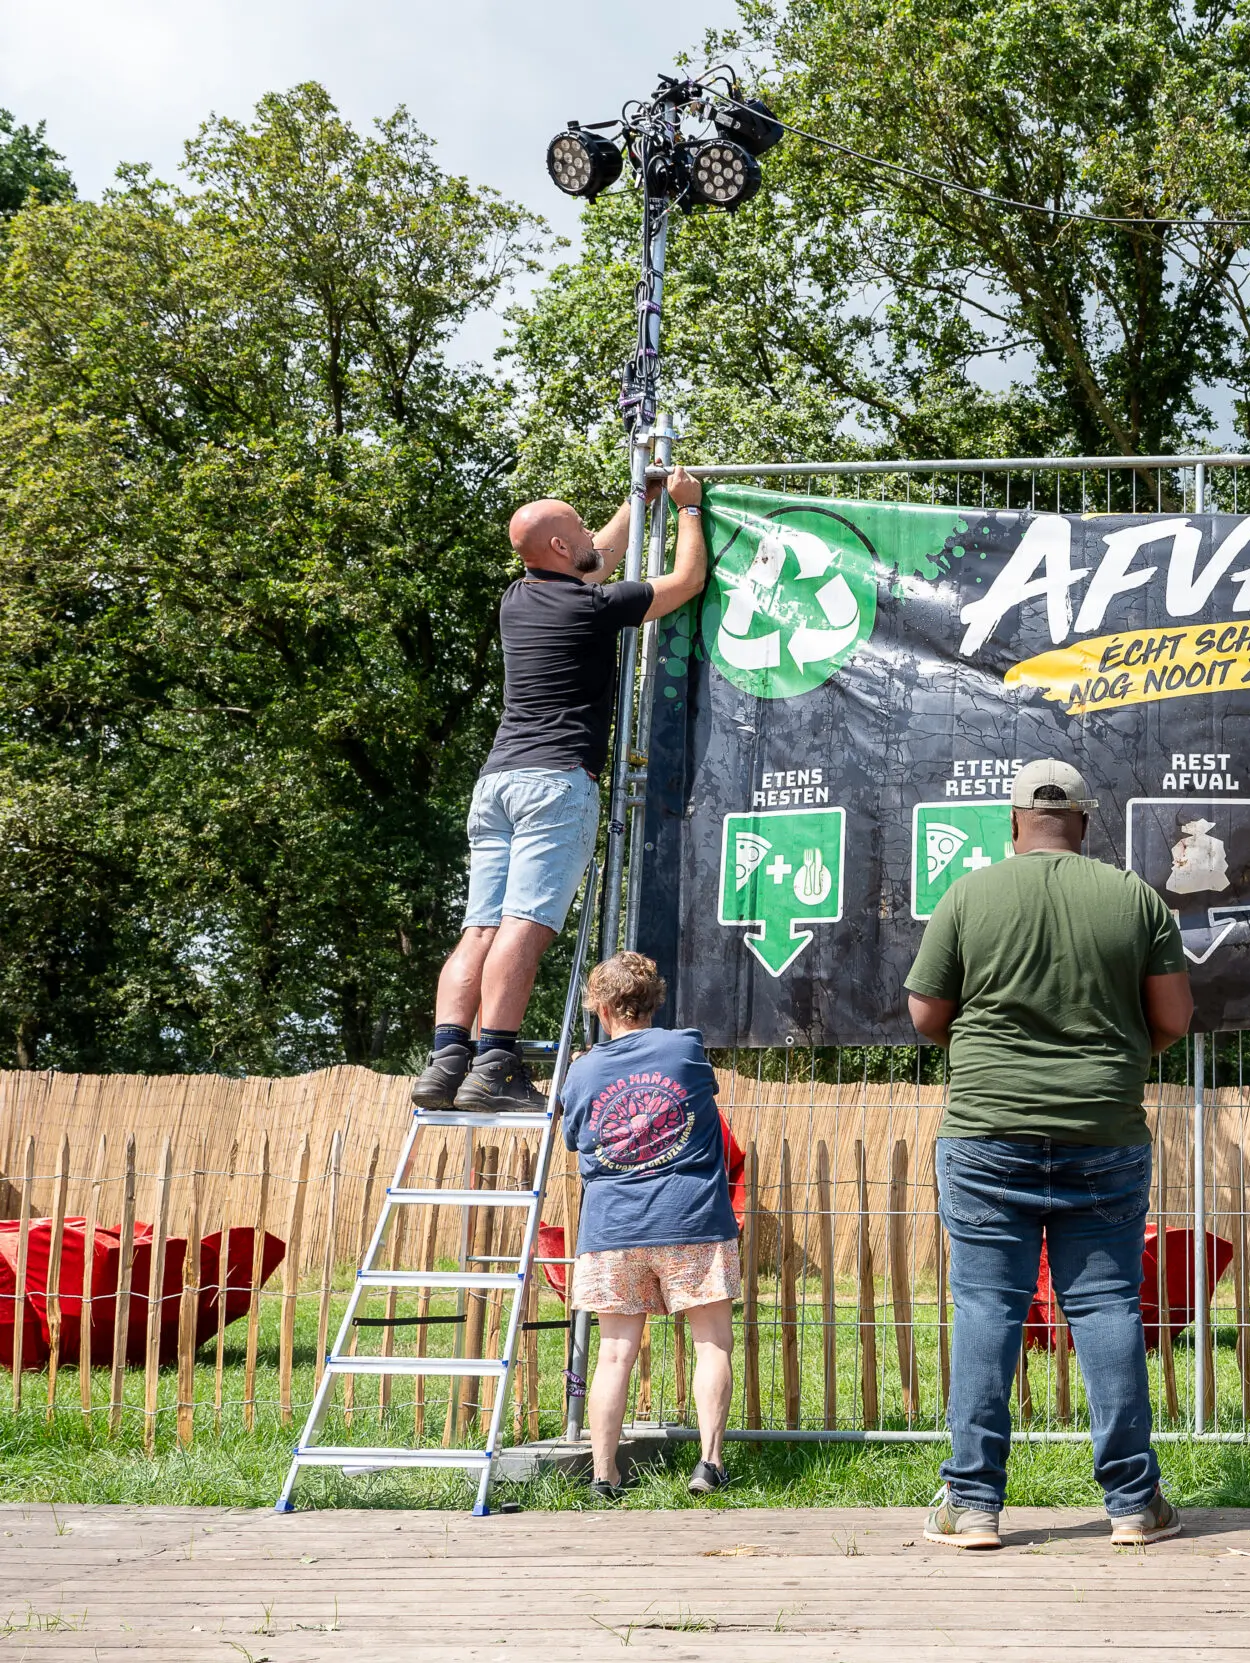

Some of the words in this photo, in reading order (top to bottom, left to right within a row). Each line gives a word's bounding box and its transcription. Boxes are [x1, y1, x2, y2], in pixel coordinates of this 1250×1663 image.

[1098, 634, 1185, 673] ÉCHT
[1067, 675, 1136, 706] NOG
[1142, 658, 1238, 695] NOOIT
[953, 758, 1023, 777] ETENS
[1171, 753, 1231, 771] REST
[762, 768, 823, 790] ETENS
[945, 777, 1013, 796] RESTE
[1162, 772, 1239, 791] AFVAL
[753, 786, 829, 807] RESTEN
